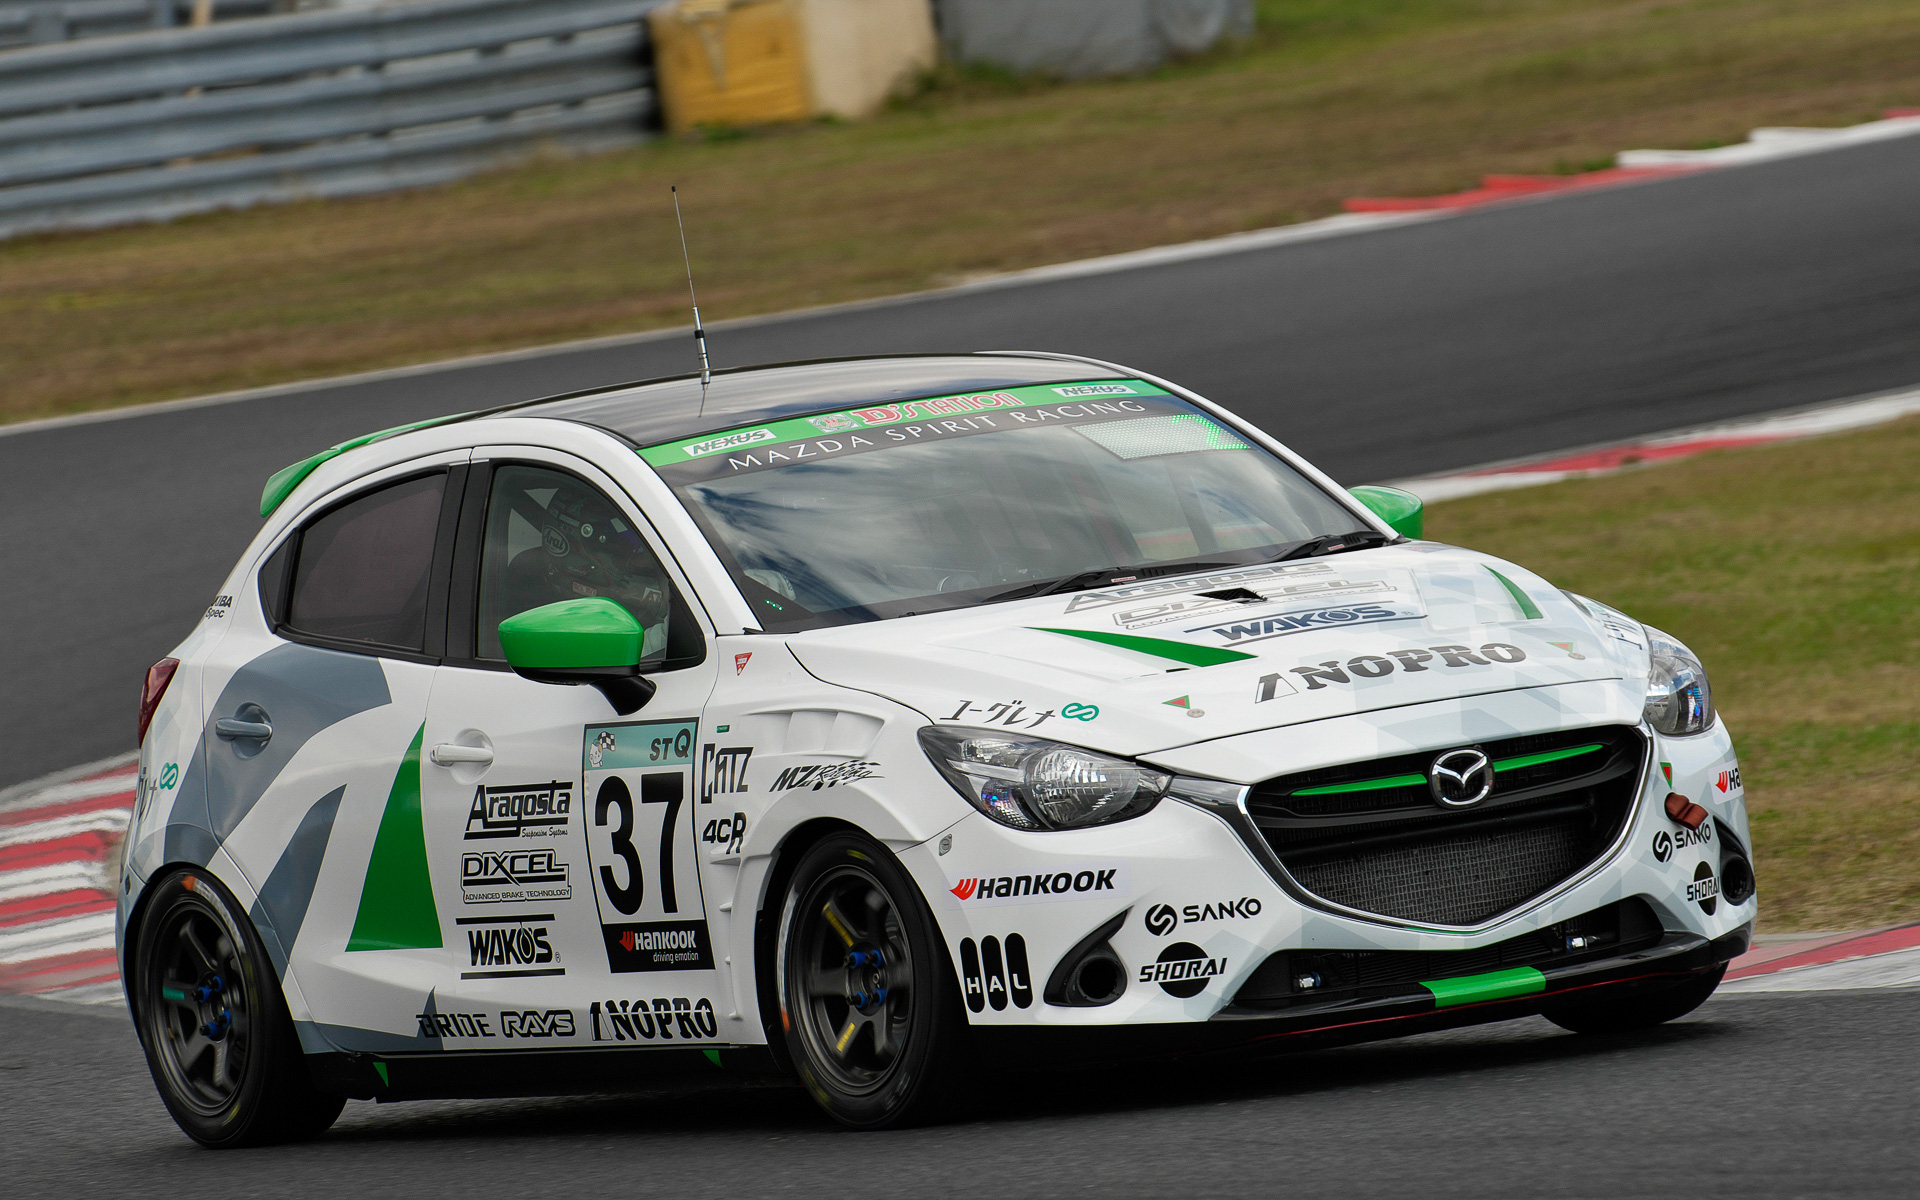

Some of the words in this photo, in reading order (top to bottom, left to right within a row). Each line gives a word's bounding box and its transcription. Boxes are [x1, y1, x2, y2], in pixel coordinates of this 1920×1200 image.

[1061, 384, 1128, 396] NEXUS
[692, 430, 769, 454] NEXUS
[728, 435, 874, 470] MAZDA
[885, 415, 997, 441] SPIRIT
[1009, 400, 1146, 423] RACING
[939, 699, 1057, 730] ユーグレナ
[464, 780, 573, 839] Aragosta
[595, 771, 684, 916] 37
[463, 853, 565, 884] DIXCEL
[465, 892, 500, 901] ADVANCED
[501, 890, 525, 899] BRAKE
[526, 888, 570, 898] TECHNOLOGY
[1182, 896, 1262, 923] SANKO
[652, 951, 674, 964] driving
[675, 951, 699, 962] emotion
[1139, 957, 1228, 983] SHORAI
[966, 973, 1028, 994] HAL
[415, 1013, 497, 1038] BRIDE
[500, 1009, 576, 1038] RAYS
